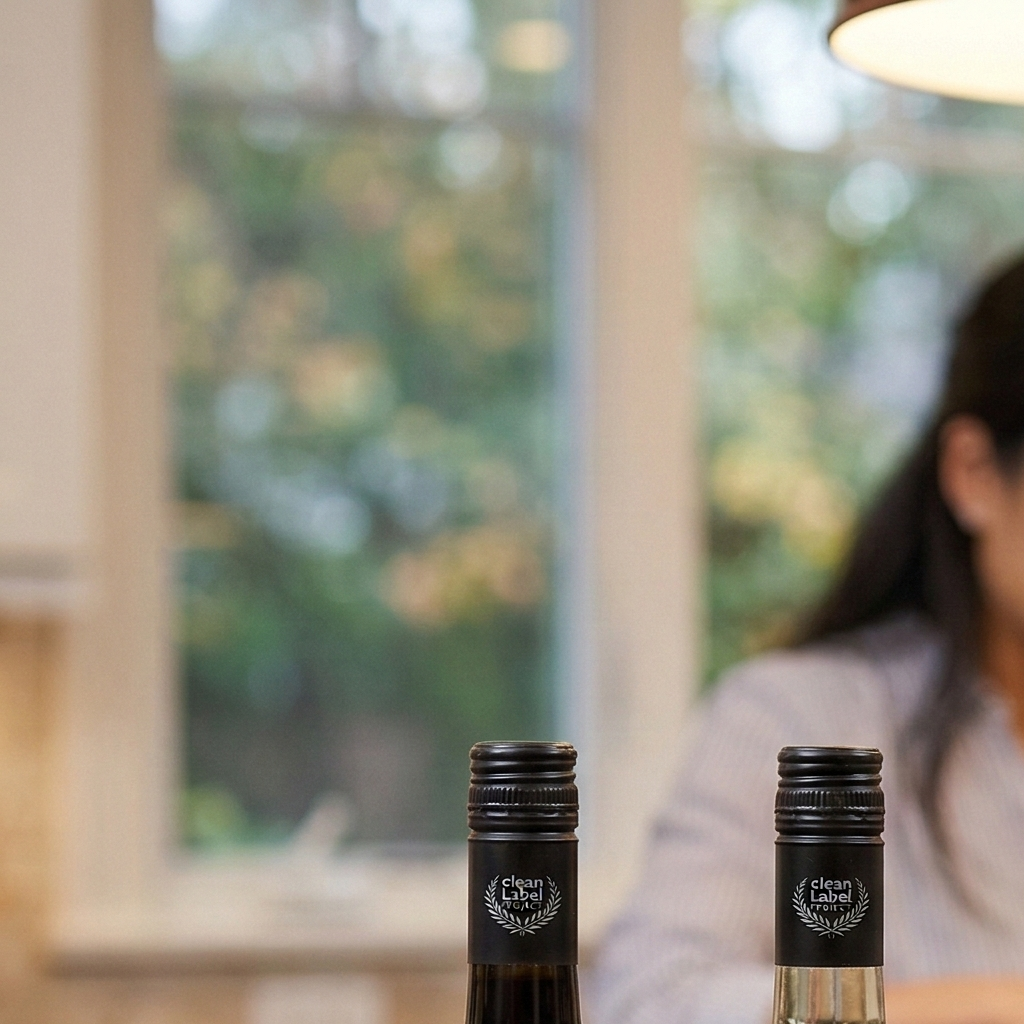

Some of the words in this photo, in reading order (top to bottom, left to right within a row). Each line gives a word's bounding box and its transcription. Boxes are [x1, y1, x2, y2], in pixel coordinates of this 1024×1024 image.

[502, 875, 543, 888] clean
[811, 877, 852, 889] clean
[811, 889, 852, 902] Label
